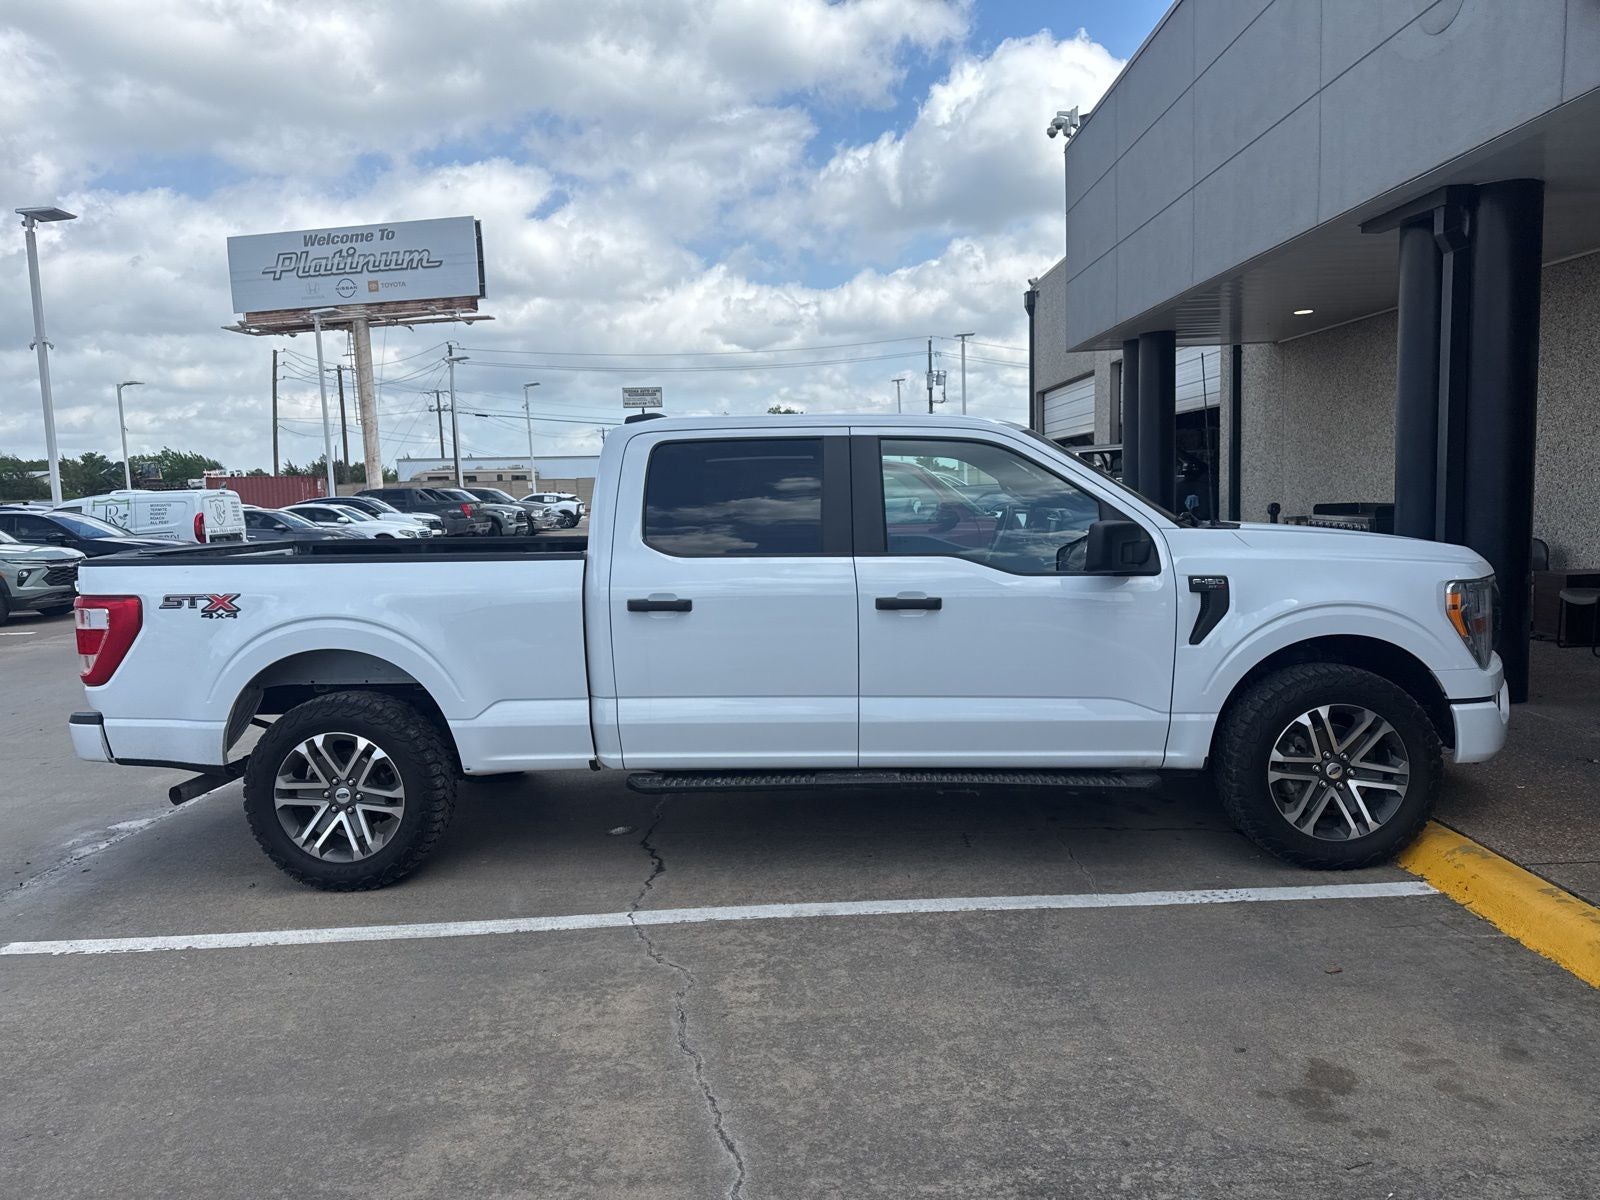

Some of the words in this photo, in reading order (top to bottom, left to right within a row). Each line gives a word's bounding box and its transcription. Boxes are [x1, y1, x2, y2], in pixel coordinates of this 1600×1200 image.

[303, 231, 374, 247] Welcome
[379, 228, 395, 241] To
[262, 246, 443, 281] Platinum
[381, 281, 406, 289] TOYOTA
[159, 593, 242, 612] STX
